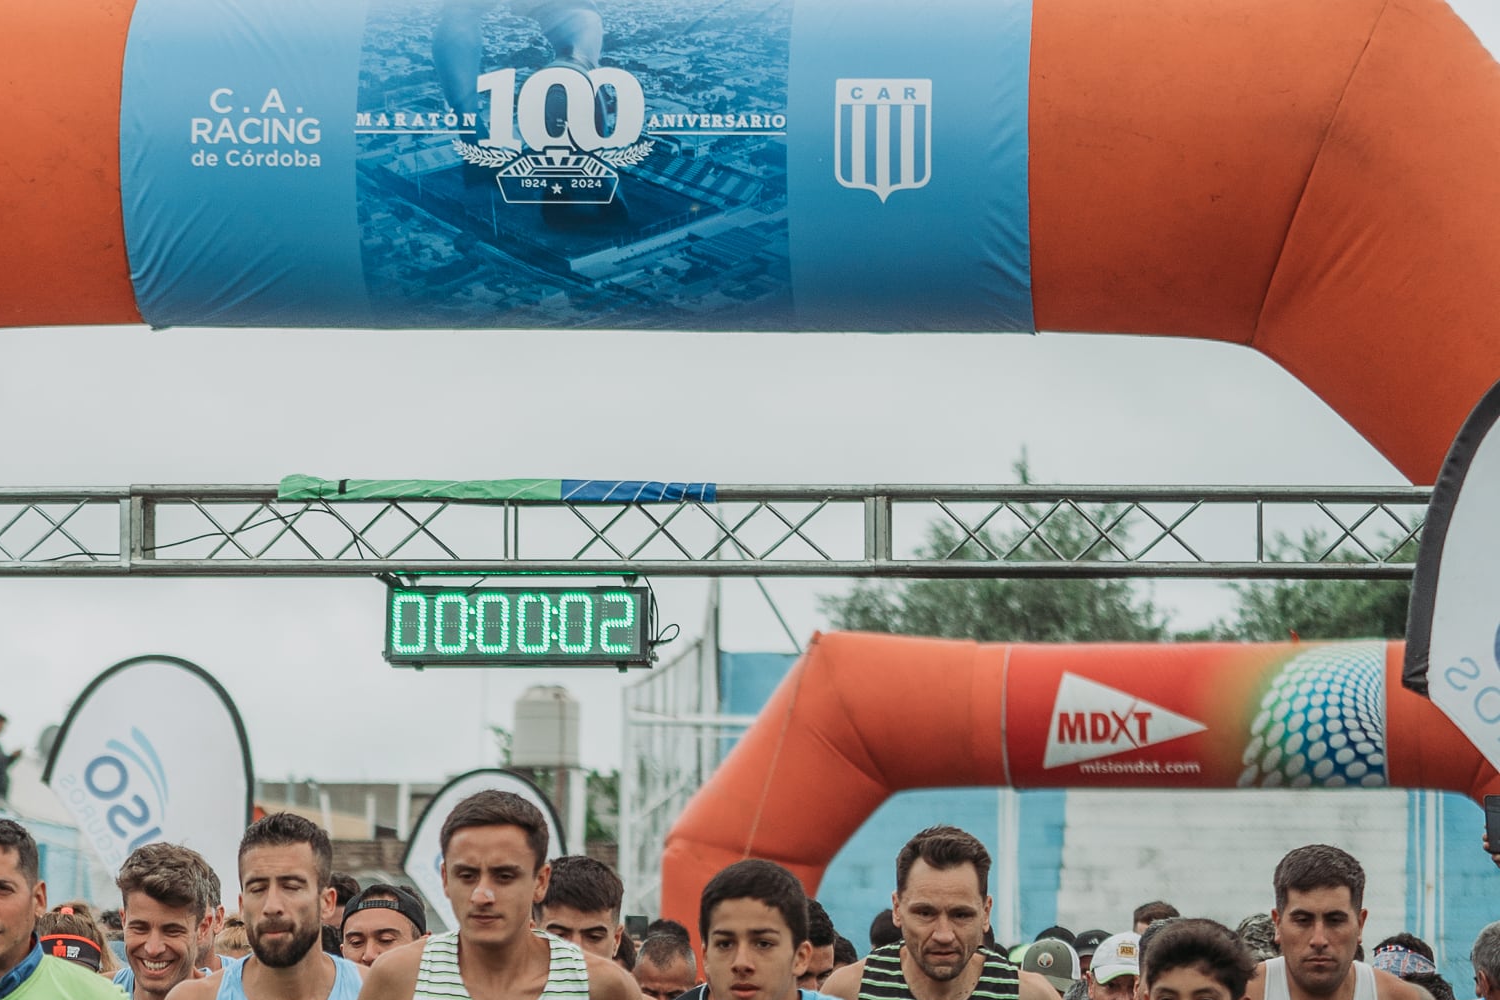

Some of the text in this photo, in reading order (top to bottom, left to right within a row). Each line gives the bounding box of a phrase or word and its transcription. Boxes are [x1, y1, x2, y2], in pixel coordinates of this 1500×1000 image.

[355, 66, 787, 154] MARATÓN 100 ANIVERSARIO
[190, 117, 322, 145] RACING
[190, 149, 322, 168] de Córdoba
[520, 179, 603, 189] 1924 2024
[392, 591, 636, 655] 00:00:02
[1057, 708, 1153, 748] MDXT
